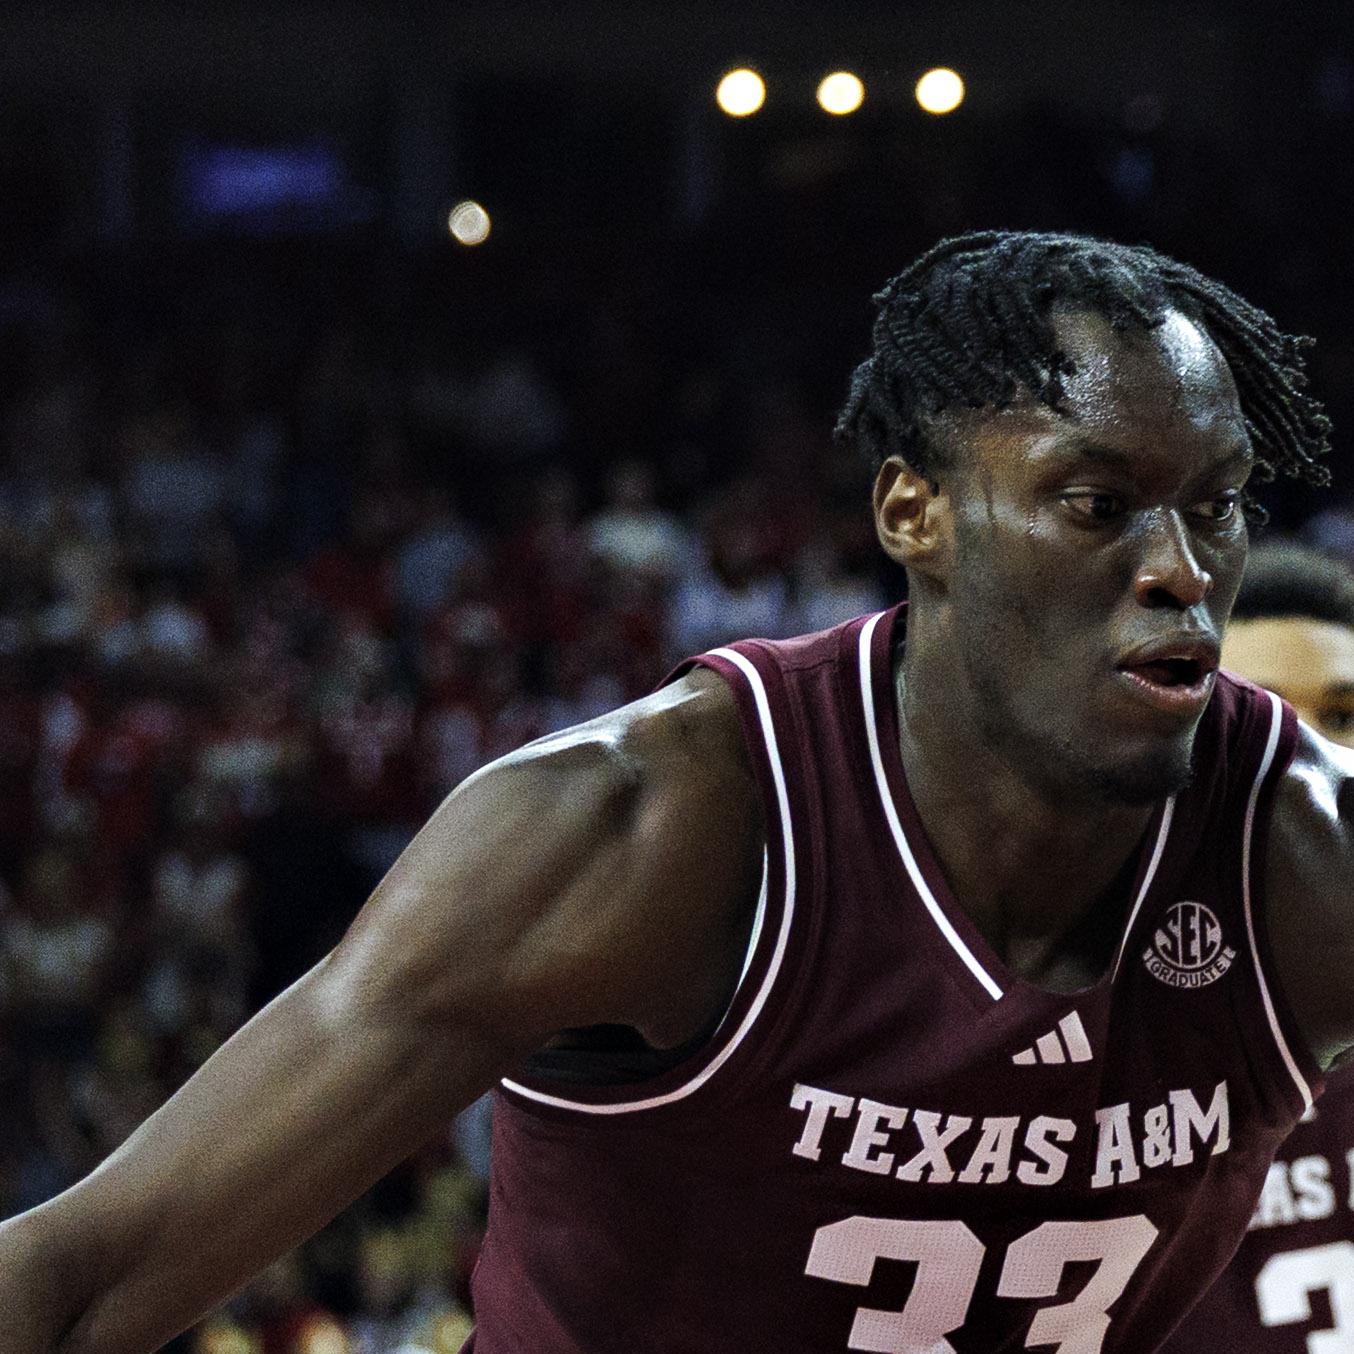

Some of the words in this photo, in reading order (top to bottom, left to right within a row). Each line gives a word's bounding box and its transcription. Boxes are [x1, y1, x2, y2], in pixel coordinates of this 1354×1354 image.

[1146, 948, 1234, 988] GRADUATE
[1155, 902, 1222, 969] SEC
[791, 1083, 1074, 1186] TEXAS
[1090, 1080, 1231, 1188] A&M
